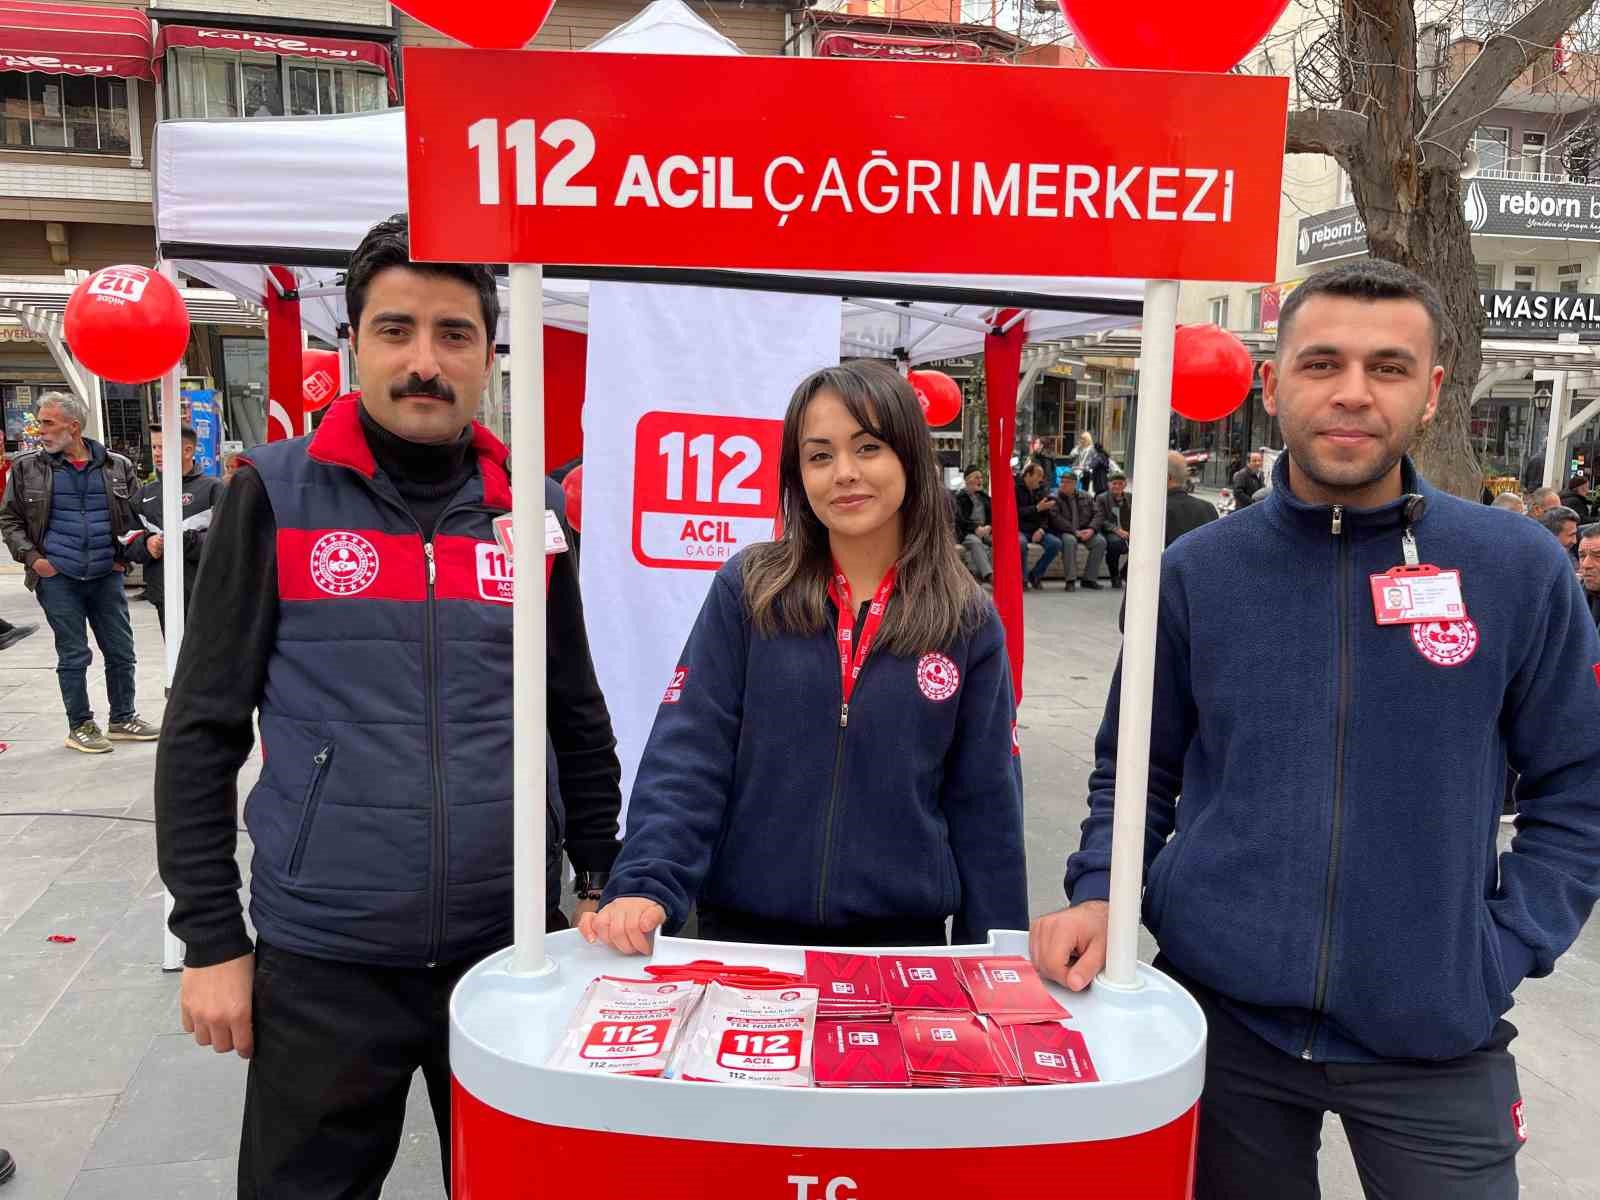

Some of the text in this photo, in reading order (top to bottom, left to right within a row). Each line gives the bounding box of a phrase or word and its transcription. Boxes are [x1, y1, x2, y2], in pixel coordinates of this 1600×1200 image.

[467, 117, 597, 207] 112
[762, 149, 961, 227] ÇAĞRI
[971, 160, 1235, 223] MERKEZİ
[1499, 190, 1581, 218] reborn
[1311, 222, 1352, 245] reborn
[98, 276, 136, 295] 112
[659, 431, 763, 506] 112
[602, 1025, 657, 1043] 112
[733, 1034, 791, 1055] 112
